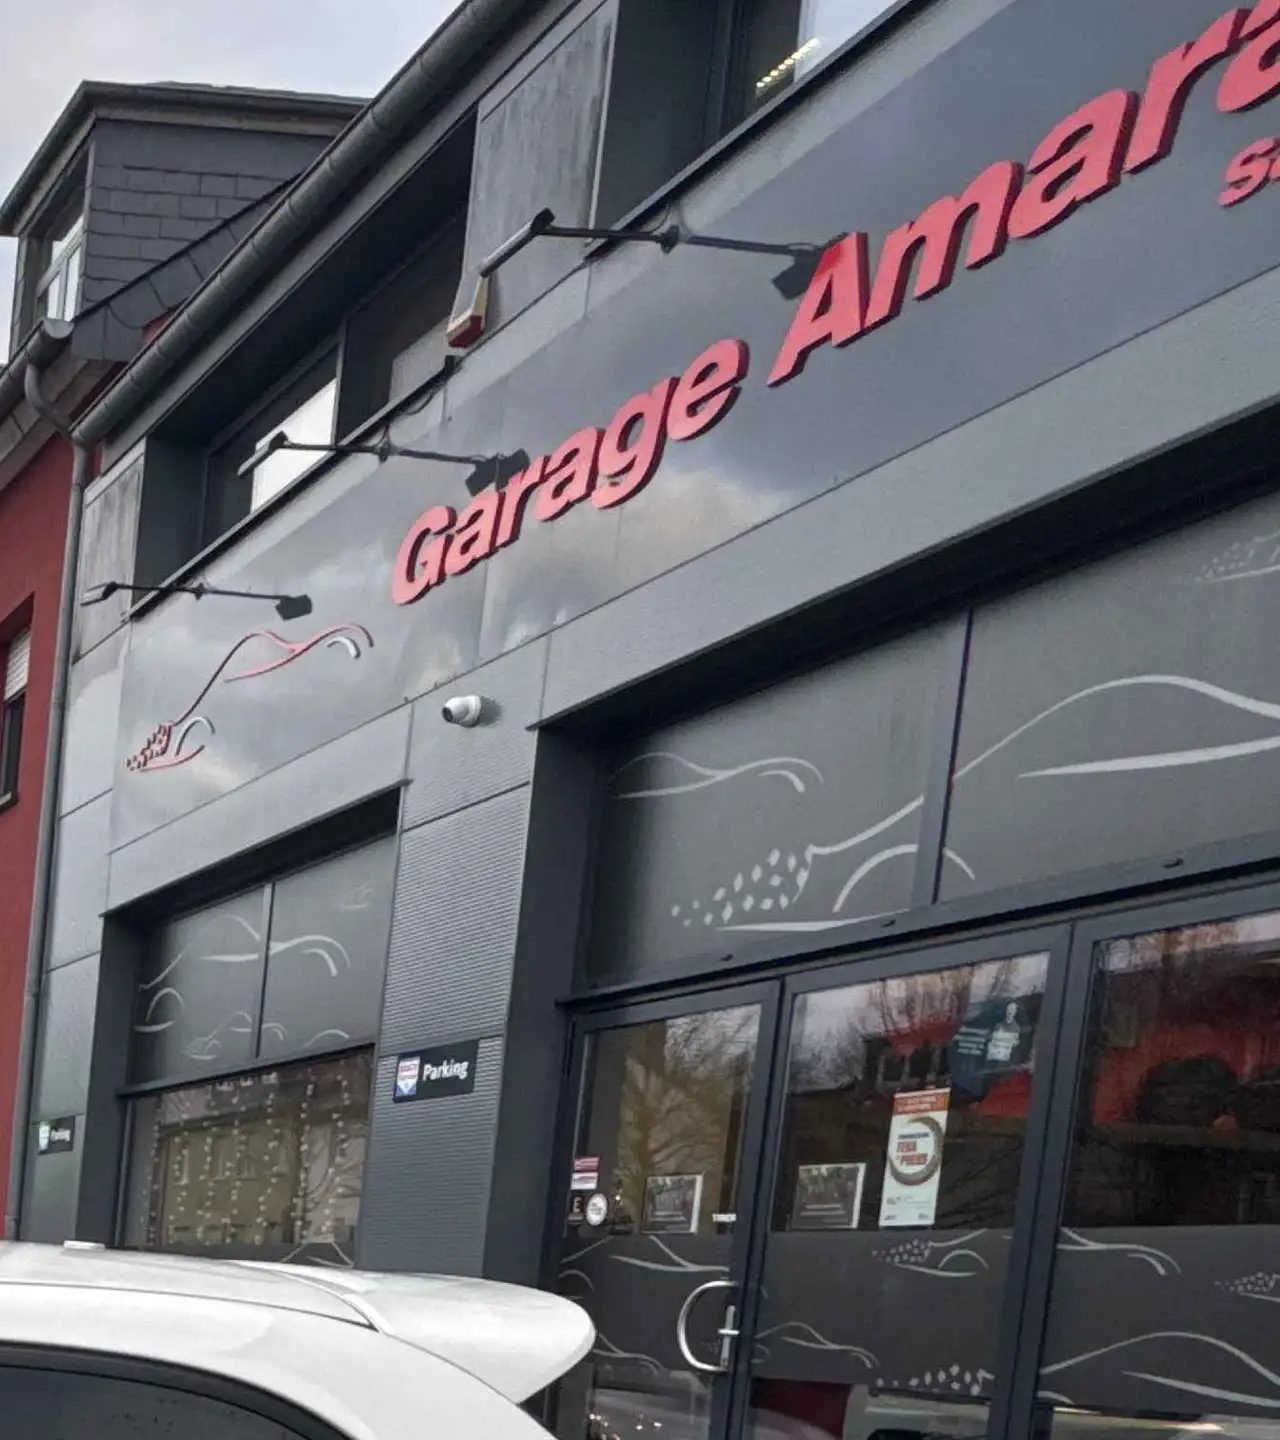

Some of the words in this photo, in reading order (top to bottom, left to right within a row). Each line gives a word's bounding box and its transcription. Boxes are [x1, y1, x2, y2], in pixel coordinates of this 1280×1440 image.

[1217, 137, 1280, 208] S
[392, 338, 747, 605] Garage
[422, 1058, 469, 1082] Parking
